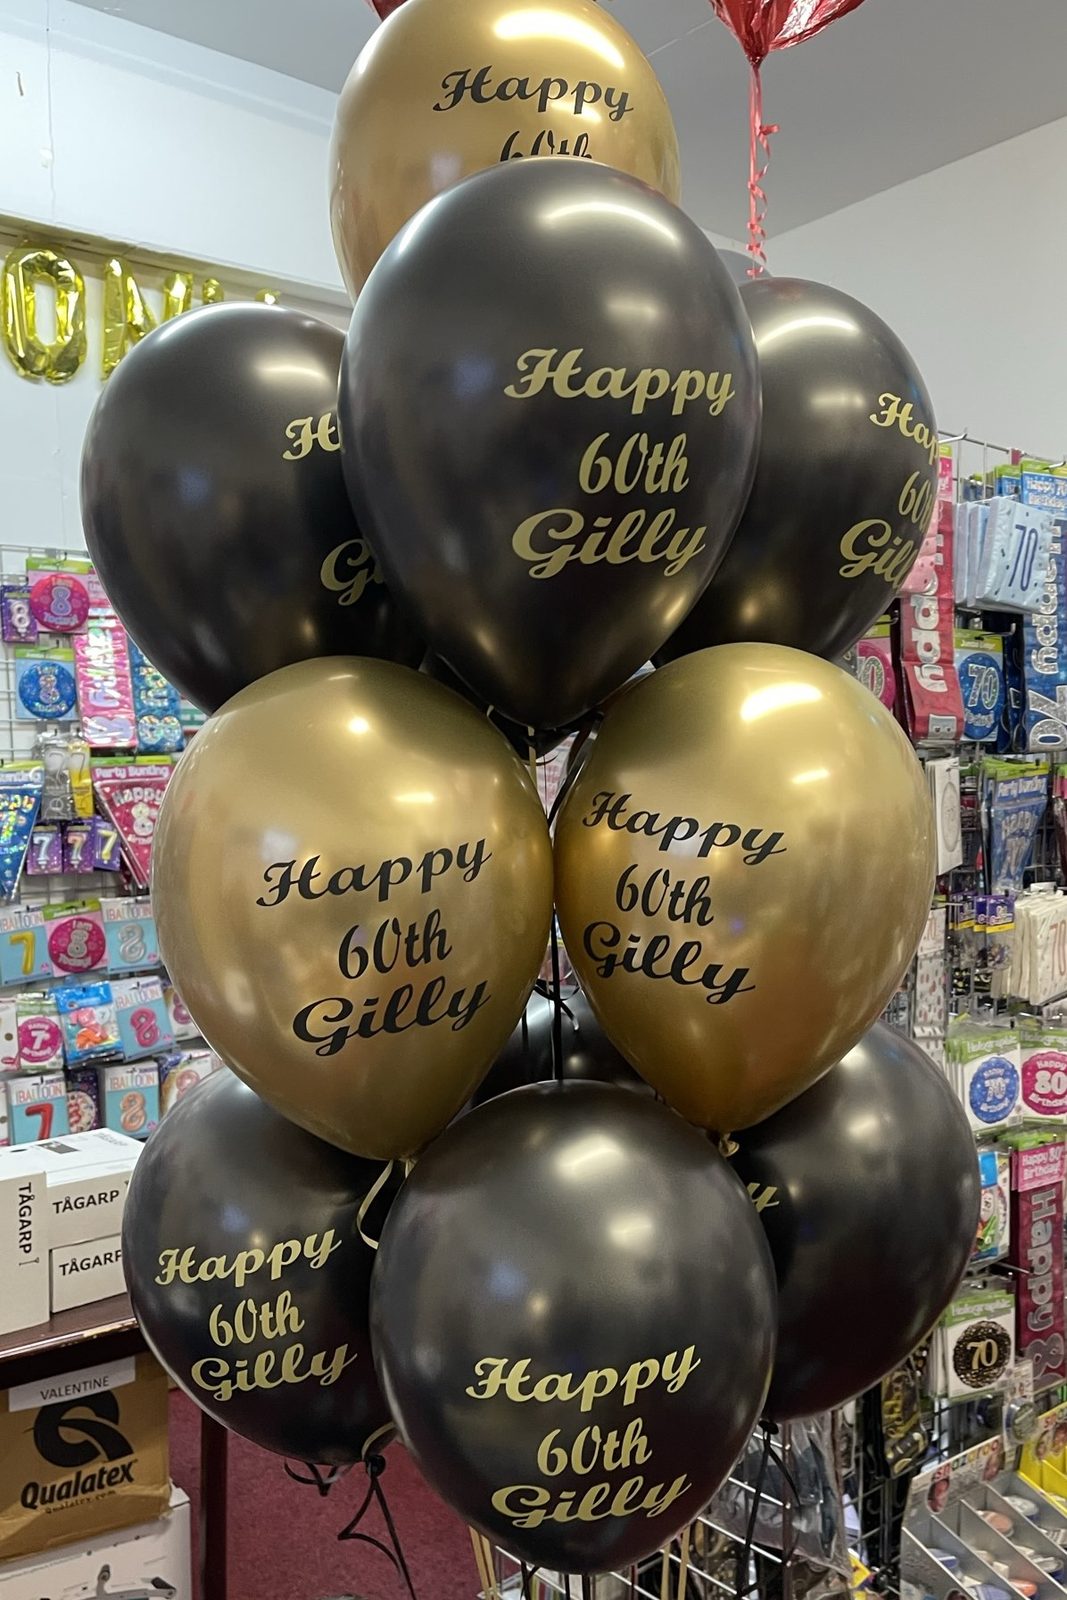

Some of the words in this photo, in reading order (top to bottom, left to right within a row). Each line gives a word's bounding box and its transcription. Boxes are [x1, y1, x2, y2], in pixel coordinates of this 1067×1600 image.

[433, 65, 634, 121] Happy
[504, 348, 735, 416] Happy
[282, 412, 341, 460] H
[870, 393, 939, 465] Hap
[579, 432, 689, 494] 60th
[512, 508, 706, 579] Gilly
[1009, 524, 1038, 590] 70
[50, 586, 72, 617] 8
[968, 664, 999, 709] 70
[131, 801, 153, 837] 8
[582, 791, 787, 865] Happy
[256, 839, 492, 906] Happy
[615, 864, 714, 927] 60th
[9, 930, 35, 975] 7
[67, 930, 89, 958] 8
[338, 908, 452, 979] 60th
[583, 921, 756, 1004] Gilly
[131, 1007, 157, 1048] 8
[292, 976, 491, 1056] Gilly
[1035, 1070, 1067, 1095] 80
[25, 1103, 53, 1140] 7
[120, 1091, 147, 1132] 8
[19, 1182, 35, 1254] TÅGARP
[52, 1190, 120, 1214] TÅGARP
[154, 1228, 342, 1288] Happy
[1027, 1188, 1057, 1332] Happy
[209, 1290, 305, 1346] 60th
[191, 1343, 358, 1402] Gilly
[465, 1345, 701, 1412] Happy
[966, 1339, 999, 1370] 70
[40, 1376, 110, 1400] VALENTINE
[537, 1417, 653, 1476] 60th
[21, 1461, 135, 1510] Qualatex
[491, 1474, 692, 1528] Gilly
